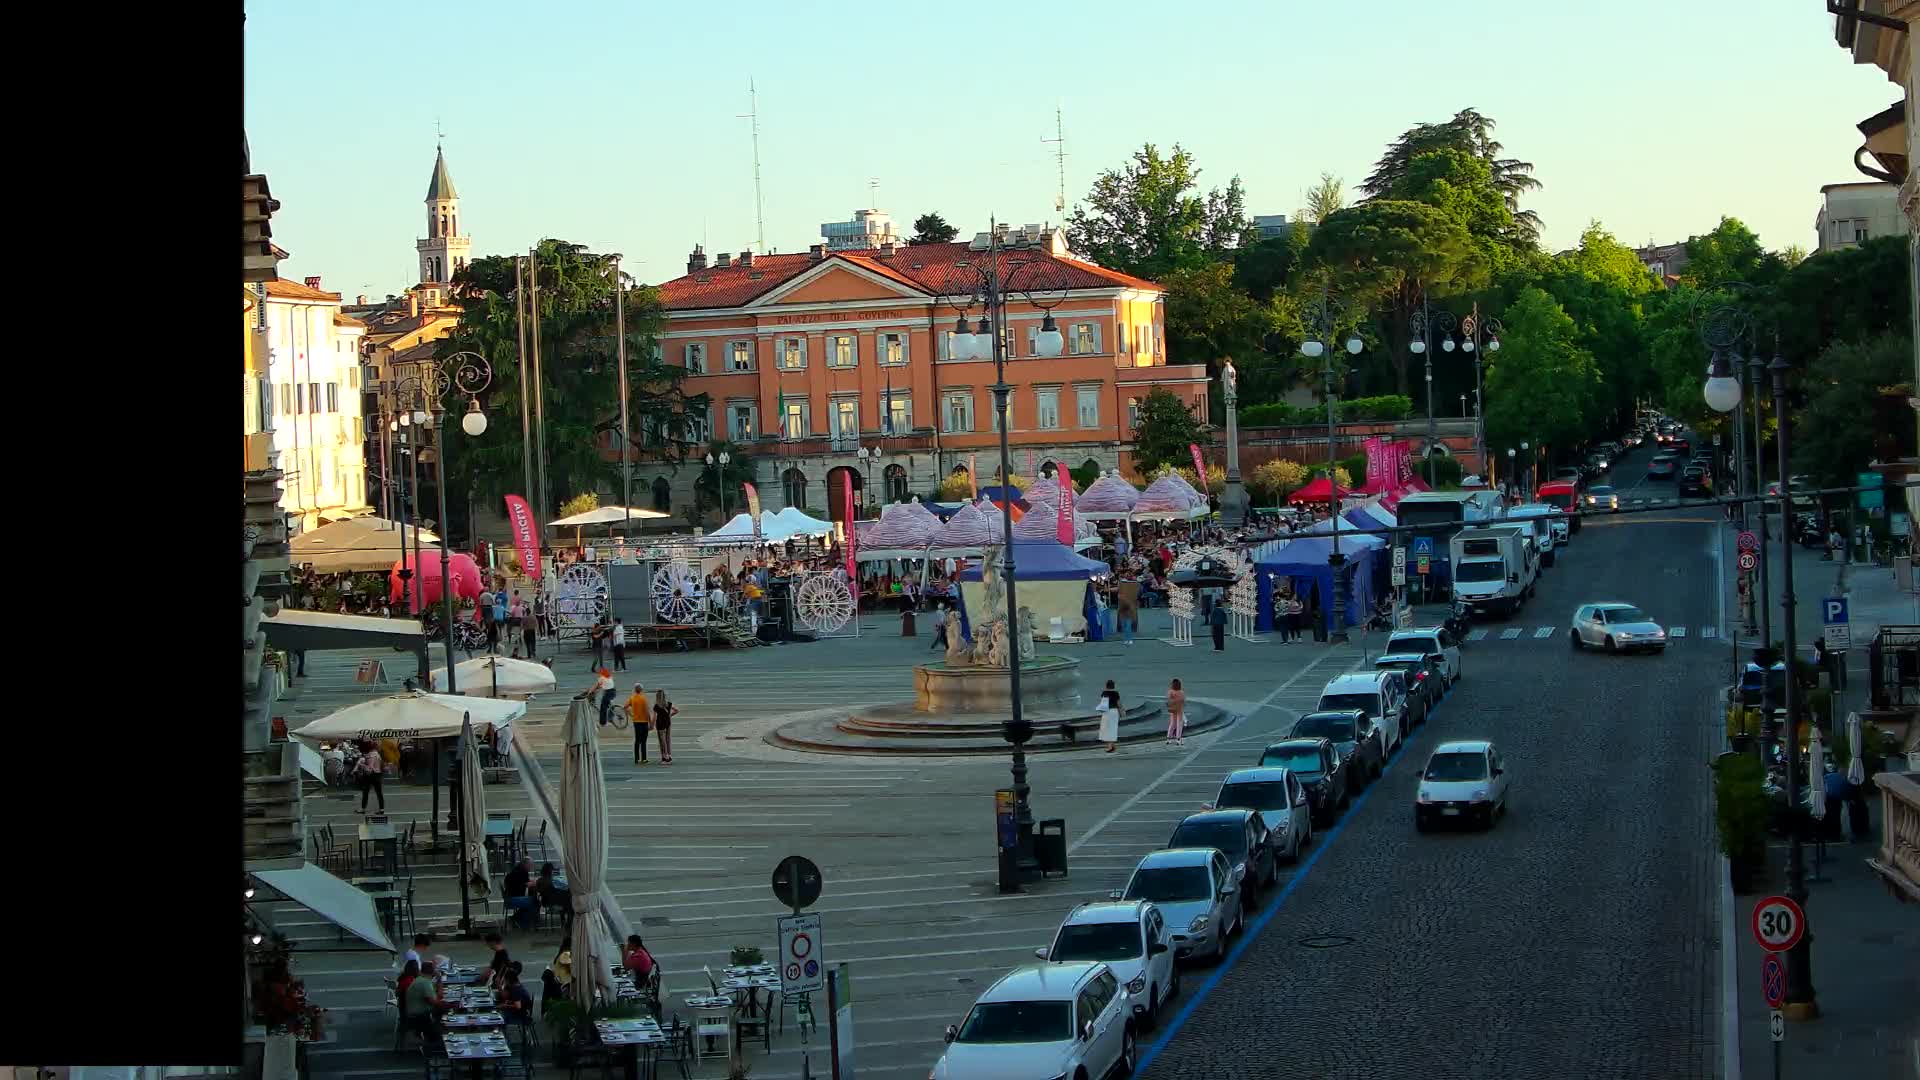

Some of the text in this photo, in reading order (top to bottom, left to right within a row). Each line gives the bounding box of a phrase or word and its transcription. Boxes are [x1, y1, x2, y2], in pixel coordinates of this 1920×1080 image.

[777, 311, 903, 325] PALAZZO DEL GOVERNO
[1743, 556, 1753, 566] 20
[1828, 601, 1842, 621] P
[358, 727, 420, 739] Piadineria
[1762, 910, 1792, 937] 30
